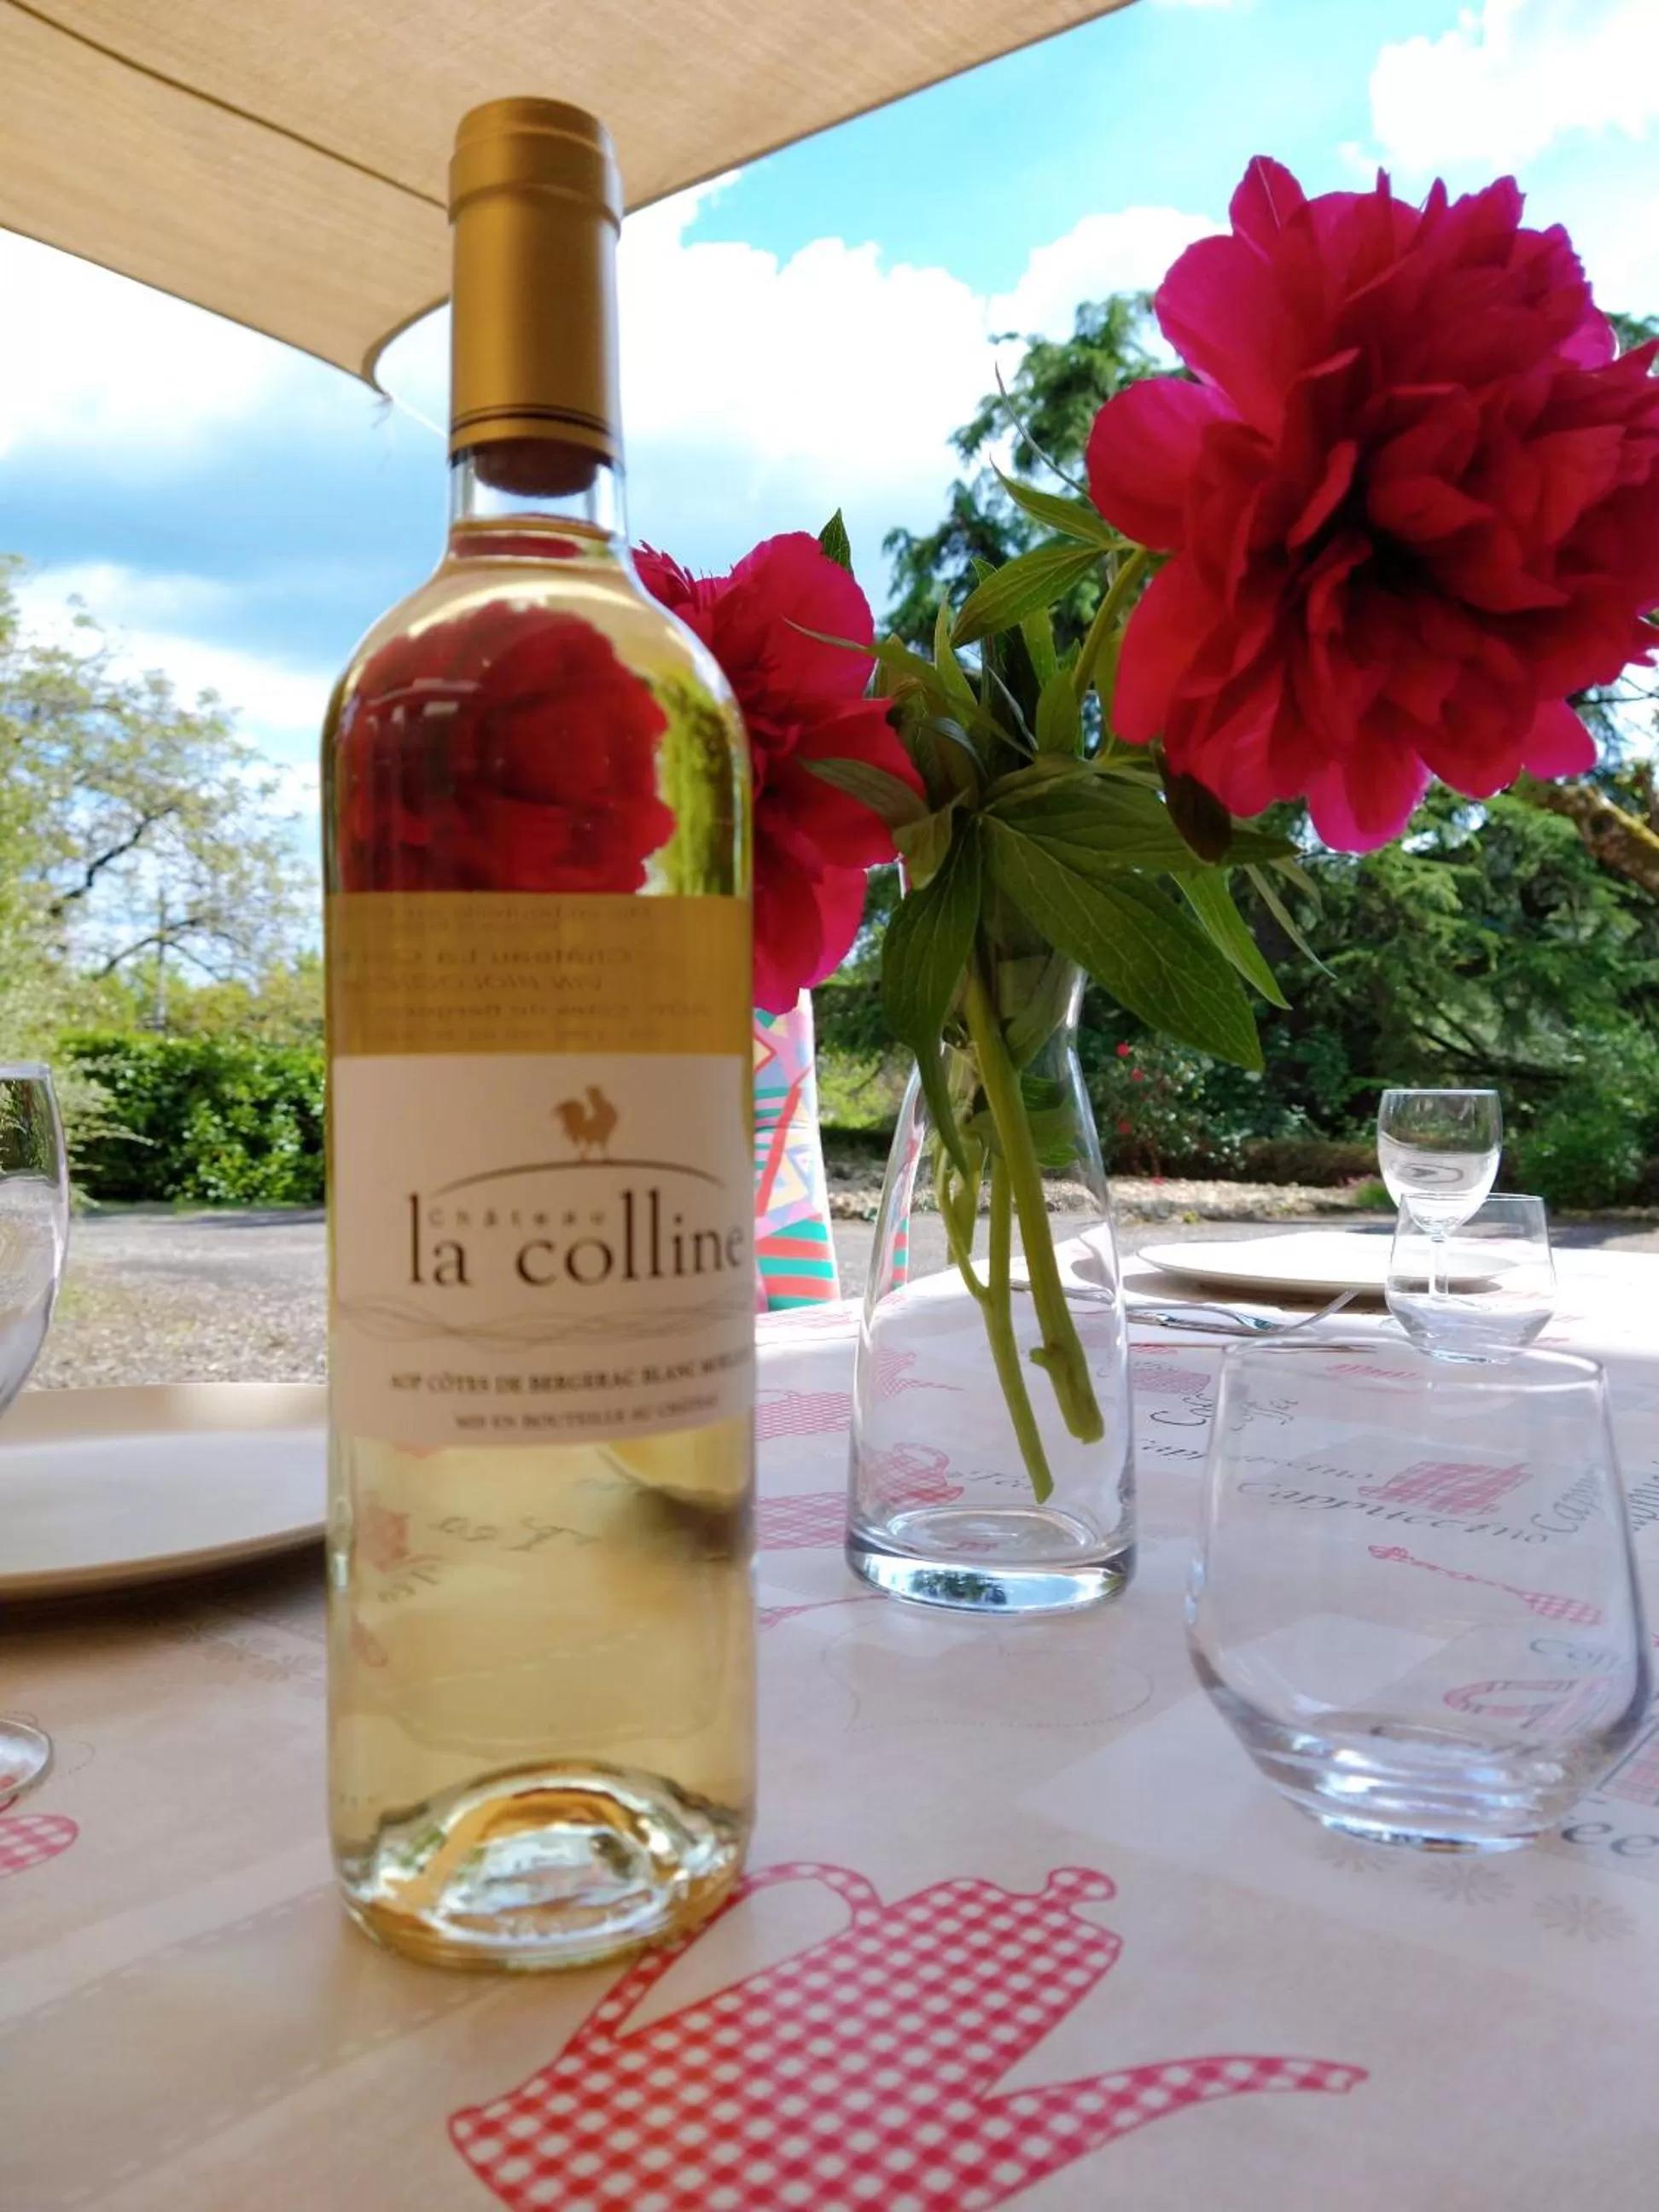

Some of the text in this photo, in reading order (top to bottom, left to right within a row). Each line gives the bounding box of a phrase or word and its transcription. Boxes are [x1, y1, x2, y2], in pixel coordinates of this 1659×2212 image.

[408, 1187, 745, 1286] la colline
[527, 1367, 634, 1395] BERGERAC
